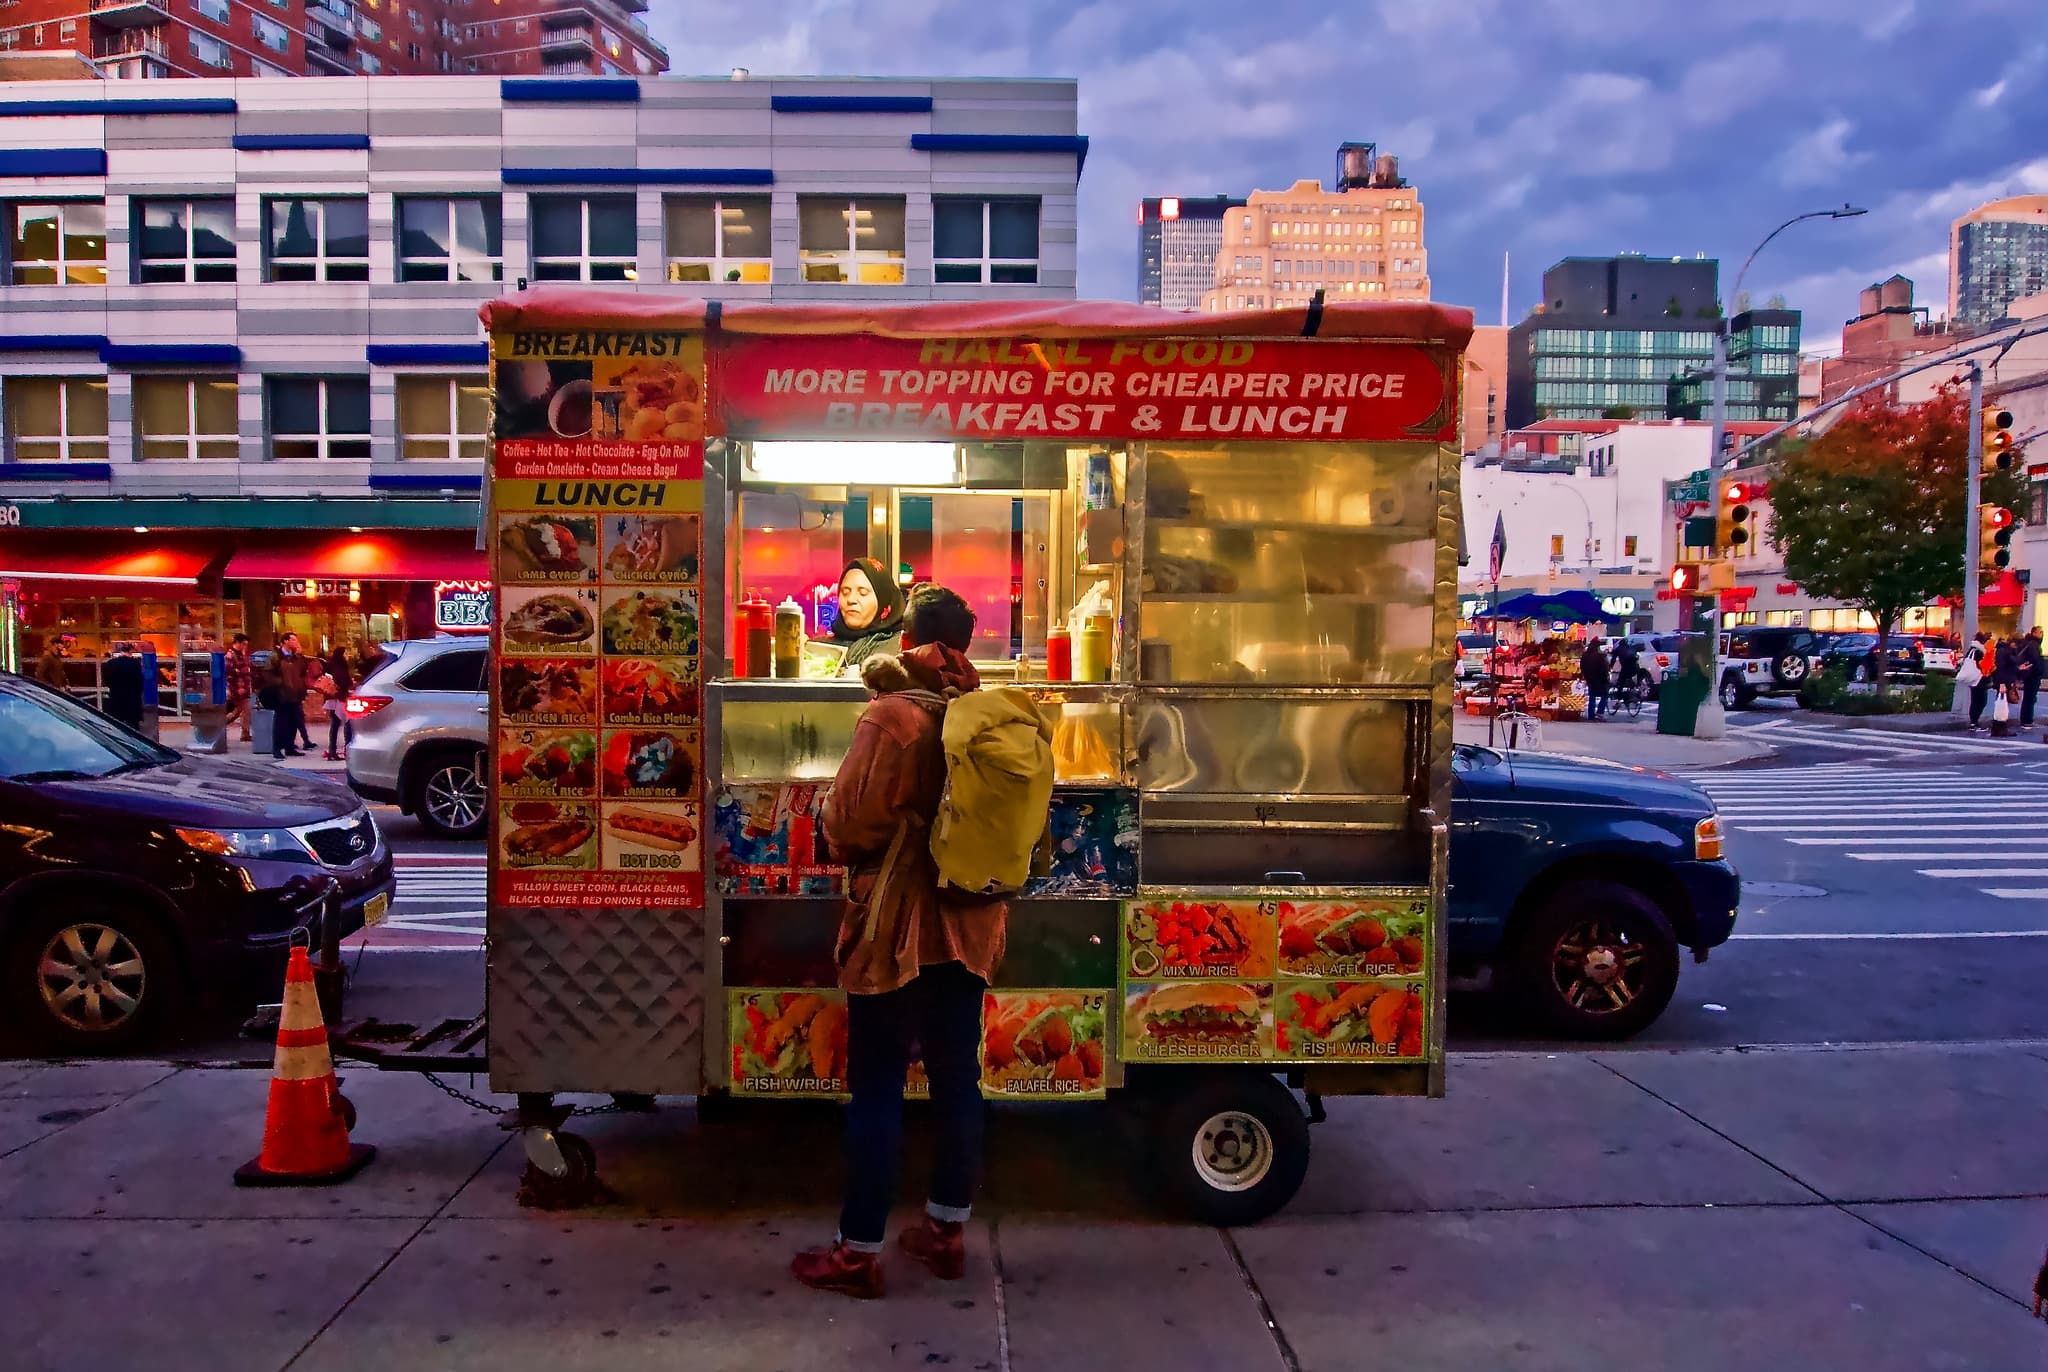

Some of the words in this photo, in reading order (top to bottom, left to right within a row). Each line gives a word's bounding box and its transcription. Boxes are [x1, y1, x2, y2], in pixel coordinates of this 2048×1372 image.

[512, 332, 688, 356] BREAKFAST
[920, 338, 1092, 364] HALAL
[1109, 340, 1254, 366] FOOD
[763, 369, 866, 393] MORE
[880, 370, 1033, 395] TOPPING
[1044, 370, 1114, 396] FOR
[1126, 373, 1294, 397] CHEAPER
[1300, 374, 1406, 398] PRICE
[824, 402, 1116, 430] BREAKFAST
[1131, 405, 1162, 431] &
[1180, 406, 1347, 432] LUNCH
[503, 444, 530, 457] Coffee
[537, 444, 552, 457] Hot
[554, 444, 569, 457] Tea
[576, 444, 591, 457] Hot
[593, 444, 634, 457] Chocolate
[642, 444, 657, 461] Egg
[659, 444, 671, 457] On
[673, 444, 689, 457] Roll
[515, 462, 544, 474] Garden
[547, 462, 584, 474] Omelette
[592, 462, 618, 475] Cream
[621, 462, 651, 475] Cheese
[654, 462, 677, 478] Bagel
[535, 483, 666, 505] LUNCH
[517, 571, 546, 580] LAMB
[549, 570, 580, 580] GYRO
[614, 571, 656, 580] CHICKEN
[659, 570, 689, 580] GYRO
[1602, 597, 1634, 615] AID
[653, 639, 687, 651] Salad
[511, 713, 557, 723] CHICKEN
[560, 713, 587, 723] RICE
[610, 713, 640, 723] Combo
[643, 713, 661, 723] Rice
[513, 787, 557, 796] FALAFEL
[560, 788, 584, 796] RICE
[624, 788, 652, 797] LAMB
[654, 788, 677, 797] RICE
[620, 854, 647, 867] HOT
[649, 854, 681, 867] DOG
[513, 883, 550, 892] YELLOW
[553, 884, 585, 892] SWEET
[620, 885, 651, 893] BLACK
[509, 896, 541, 904] BLACK
[583, 896, 602, 904] RED
[605, 897, 641, 905] ONIONS
[644, 897, 652, 905] &
[654, 897, 692, 905] CHEESE
[1163, 966, 1186, 977] MIX
[1188, 965, 1206, 977] W/
[1208, 966, 1237, 977] RICE
[1305, 964, 1362, 975] FALAFEL
[1365, 964, 1395, 975] RICE
[1137, 1043, 1260, 1057] CHEESEBURGER
[1302, 1042, 1337, 1054] FISH
[1340, 1042, 1397, 1054] W/RICE
[745, 1078, 783, 1091] FISH
[784, 1078, 841, 1091] W/RICE
[1007, 1079, 1052, 1093] FALAFEL
[1055, 1079, 1079, 1092] RICE
